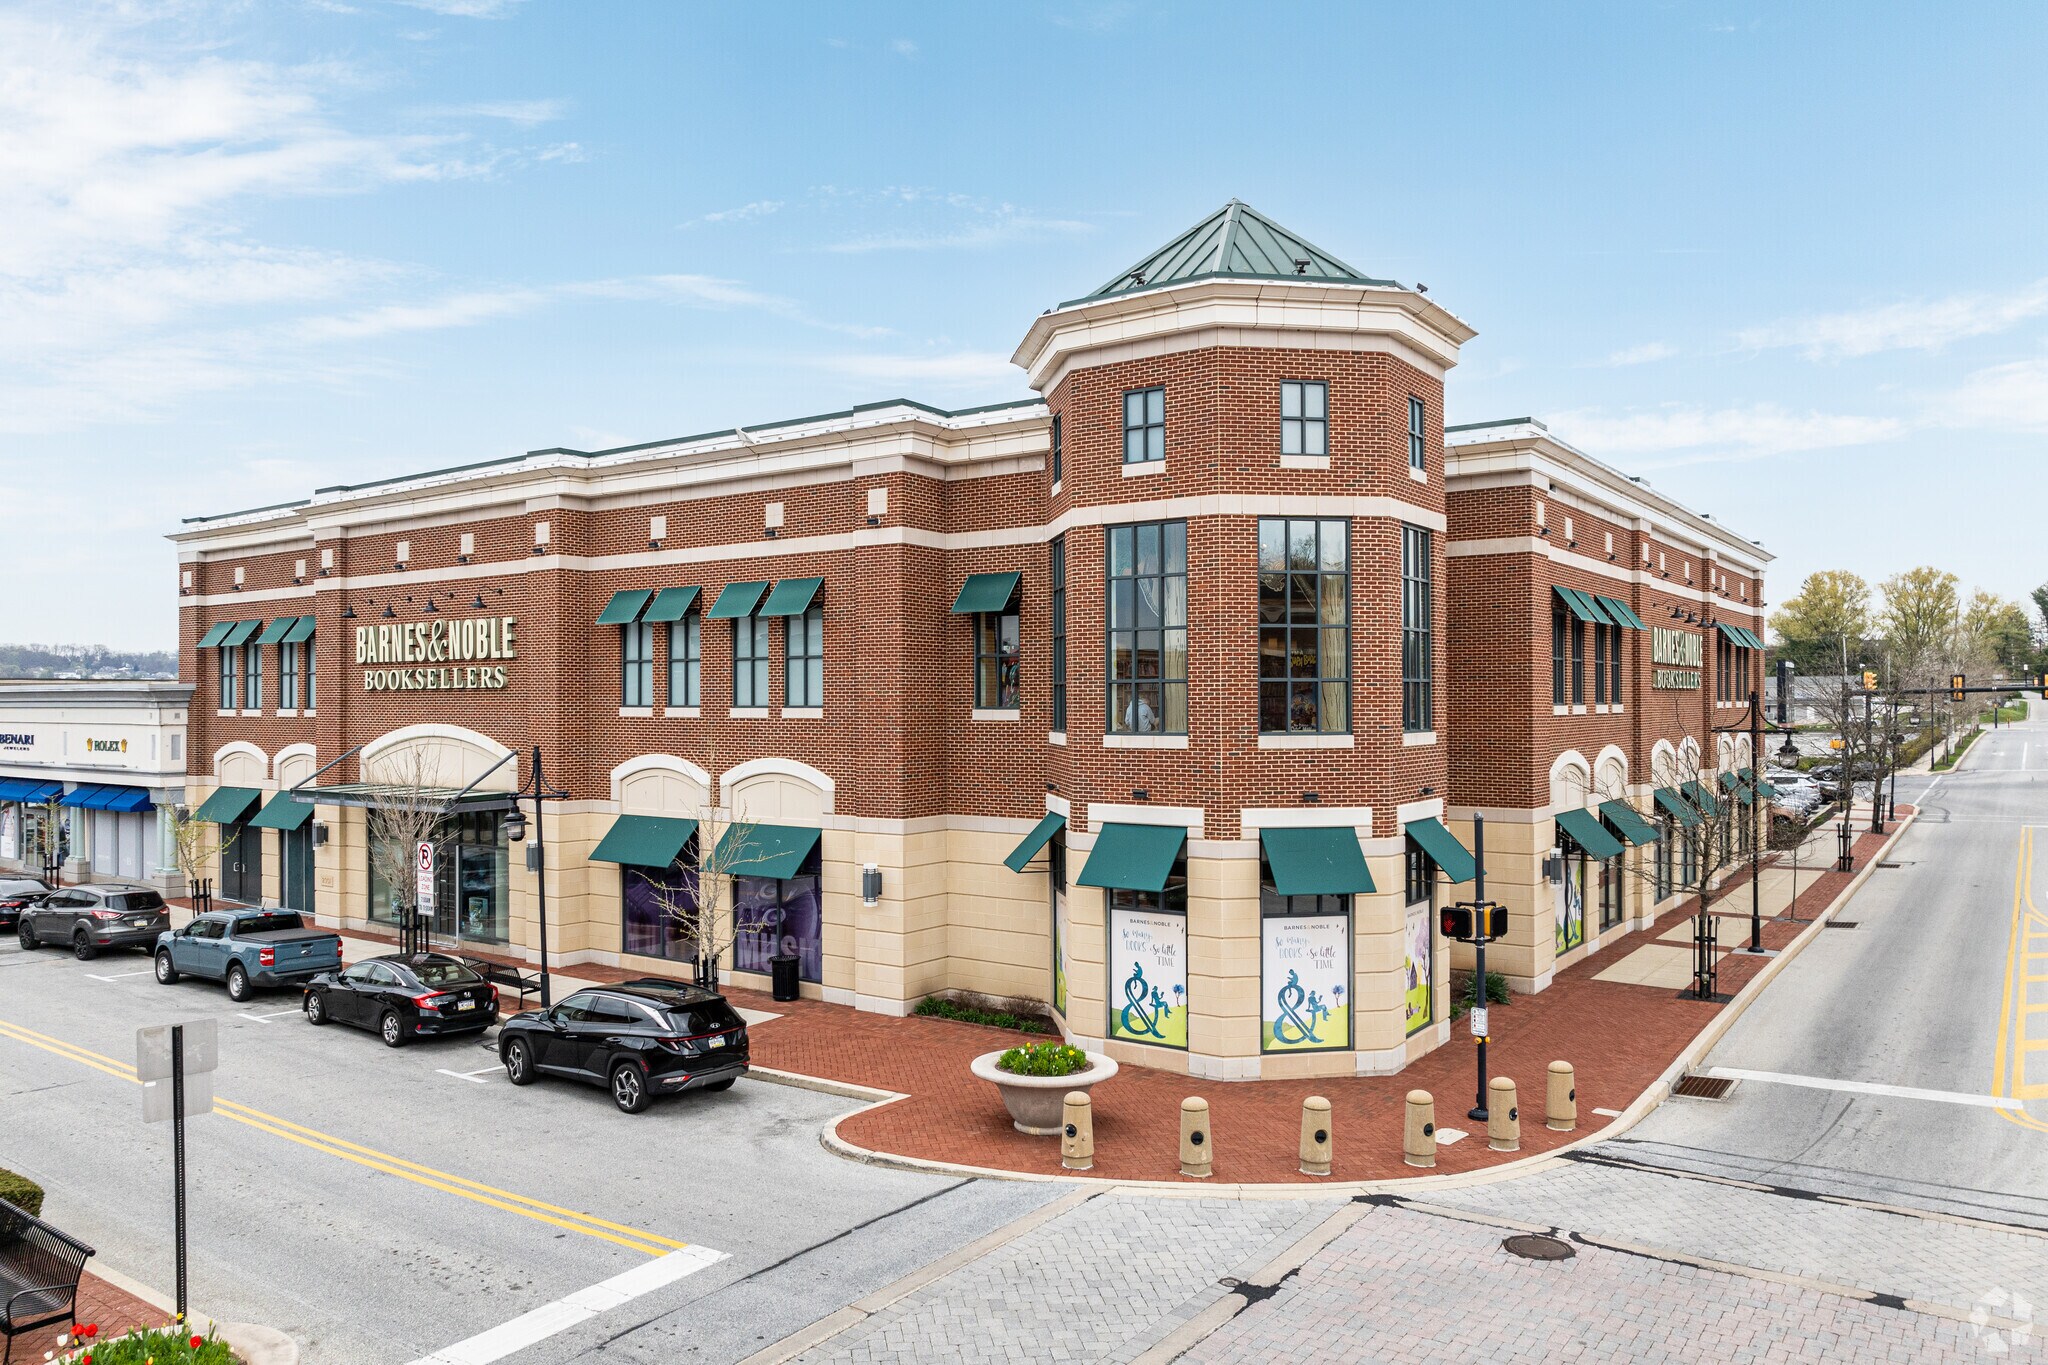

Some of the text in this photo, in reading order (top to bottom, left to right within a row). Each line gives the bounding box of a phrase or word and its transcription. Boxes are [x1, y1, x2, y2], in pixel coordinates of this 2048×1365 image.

[356, 617, 516, 663] BARNES&NOBLE
[364, 667, 507, 691] BOOKSELLERS
[1656, 669, 1701, 689] BOOKSELLERS
[0, 733, 35, 745] BENARI
[94, 740, 120, 752] ROLEX
[1155, 956, 1175, 967] TIME
[1312, 960, 1335, 970] TIME
